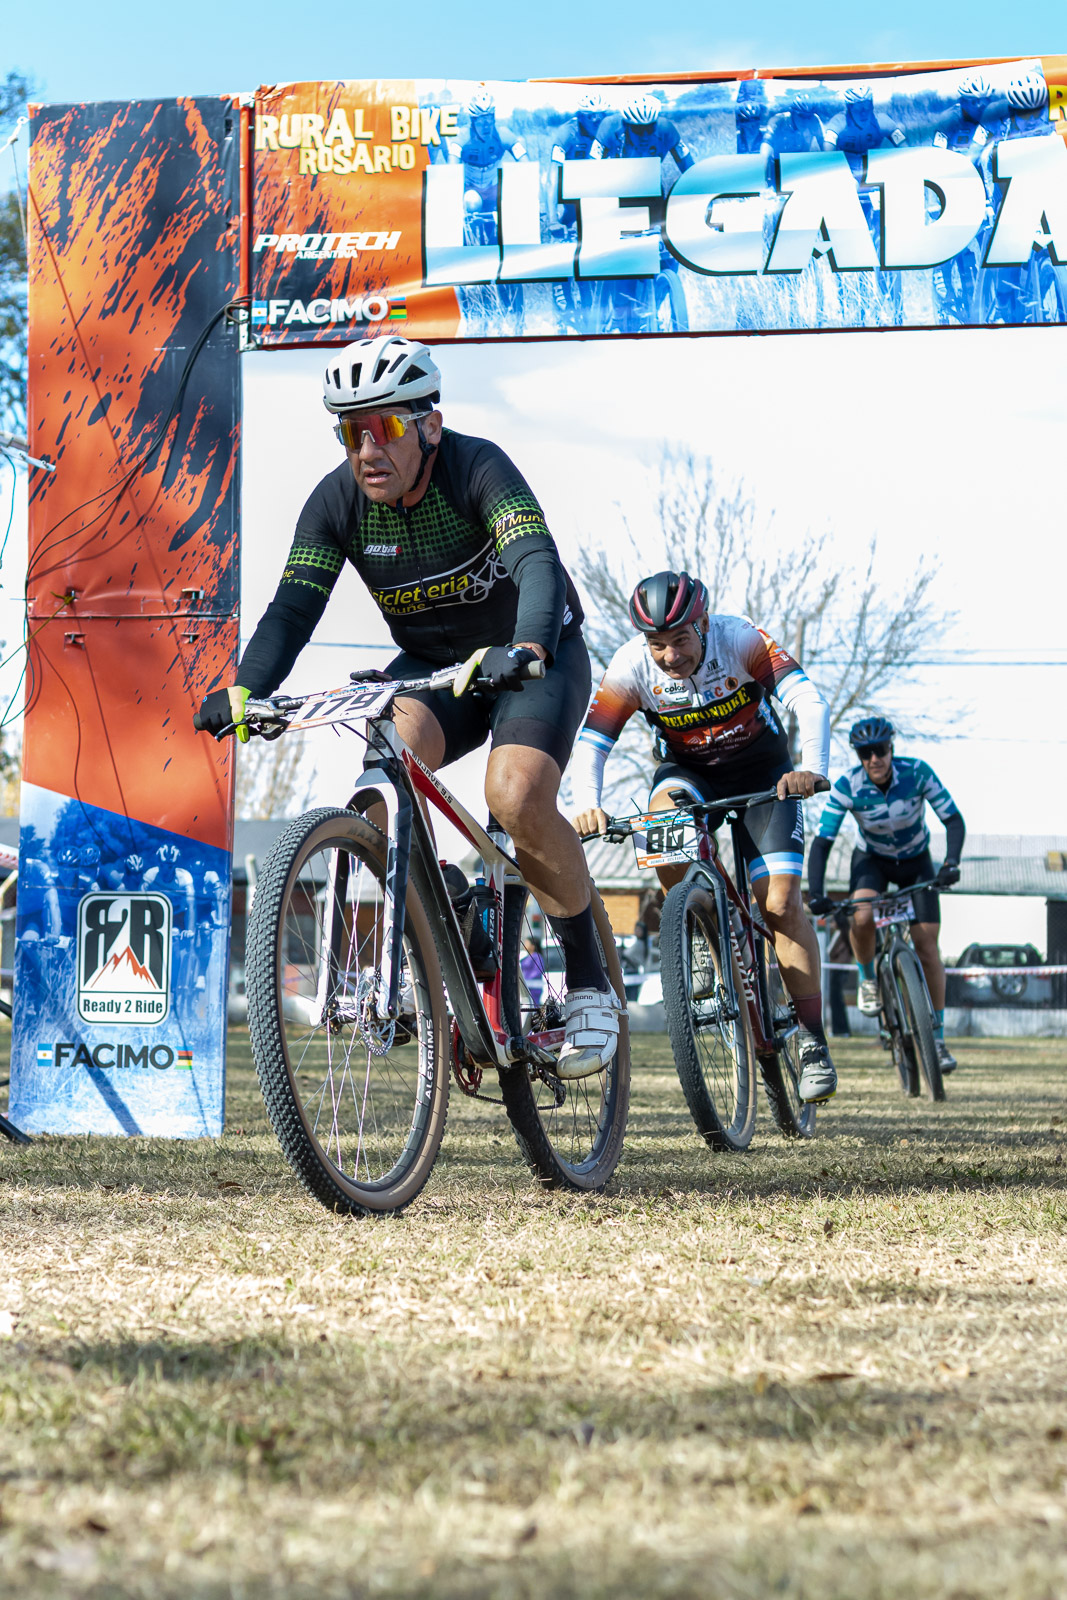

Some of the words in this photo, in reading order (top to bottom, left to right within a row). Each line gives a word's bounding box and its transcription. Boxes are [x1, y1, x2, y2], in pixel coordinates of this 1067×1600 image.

[254, 107, 374, 151] RURAL
[390, 104, 461, 147] BIKE
[299, 143, 416, 175] ROSARIO
[252, 230, 402, 253] PROTECH
[294, 250, 359, 260] ARGENTINA
[269, 296, 389, 325] FACIMO
[302, 691, 385, 720] 179
[440, 787, 453, 804] 9.5
[646, 823, 685, 854] 80
[83, 999, 121, 1014] Ready
[124, 999, 132, 1013] 2
[135, 999, 163, 1014] Ride
[54, 1043, 175, 1070] FACIMO
[425, 1018, 434, 1100] ALEXRIMS
